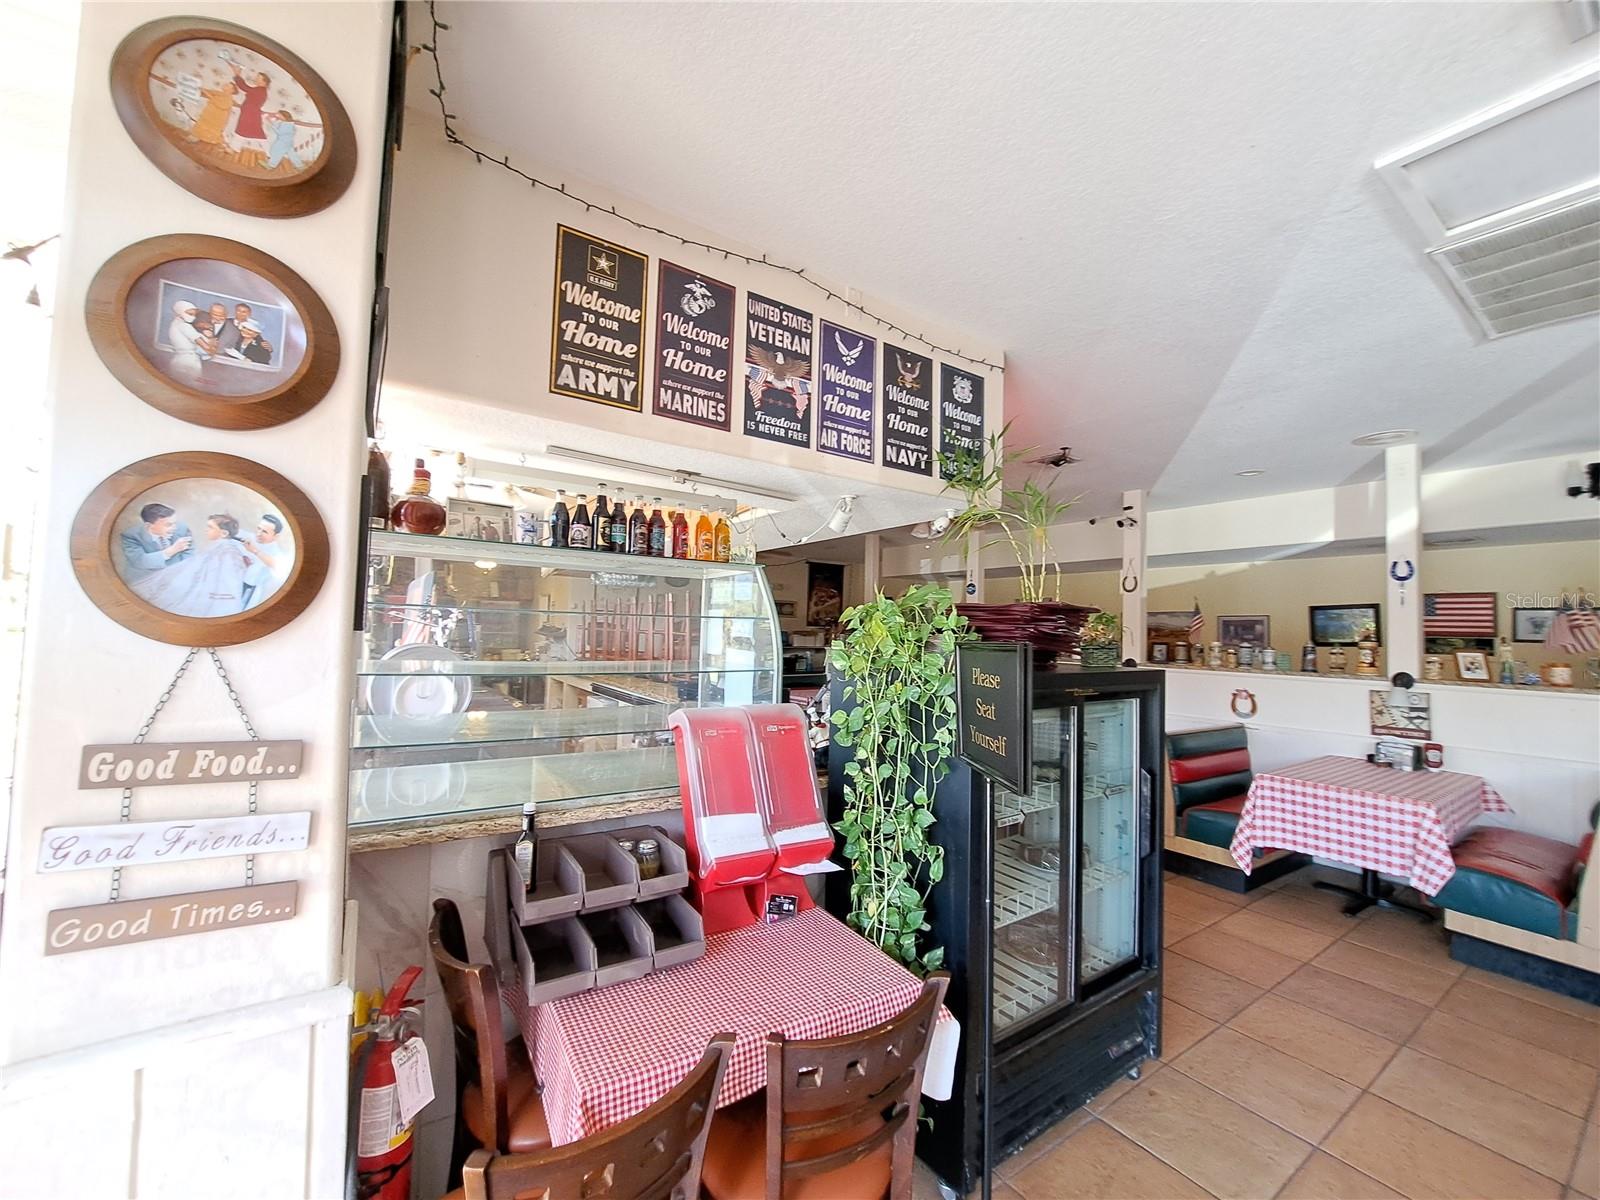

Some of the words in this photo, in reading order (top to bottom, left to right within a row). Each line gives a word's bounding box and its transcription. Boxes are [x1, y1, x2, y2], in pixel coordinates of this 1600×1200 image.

[561, 281, 641, 323] Welcome
[748, 298, 780, 323] UNITED
[782, 313, 812, 334] STATES
[582, 312, 595, 324] TO
[599, 318, 619, 331] OUR
[662, 312, 730, 350] Welcome
[561, 320, 638, 358] Home
[680, 341, 692, 352] TO
[694, 345, 711, 357] OUR
[749, 319, 811, 356] VETERAN
[662, 348, 727, 382] Home
[823, 363, 873, 393] Welcome
[556, 364, 638, 402] ARMY
[835, 387, 844, 396] TO
[846, 390, 860, 401] OUR
[660, 387, 726, 422] MARINES
[823, 394, 872, 422] Home
[886, 384, 930, 411] Welcome
[754, 410, 801, 431] Freedom
[886, 413, 929, 438] Home
[898, 406, 905, 414] TO
[907, 409, 919, 418] OUR
[943, 401, 982, 426] Welcome
[746, 420, 756, 430] IS
[758, 423, 785, 437] NEVER
[788, 430, 808, 442] FREE
[821, 428, 838, 449] AIR
[840, 433, 871, 457] FORCE
[943, 428, 981, 451] Home
[886, 445, 929, 469] NAVY
[972, 667, 1001, 689] Please
[976, 697, 996, 720] Seat
[969, 724, 1007, 757] Yourself
[87, 750, 181, 783] Good
[188, 747, 297, 778] Food...
[43, 831, 145, 869] Good
[155, 819, 306, 857] Friends...
[50, 908, 152, 949] Good
[170, 900, 291, 930] Times...
